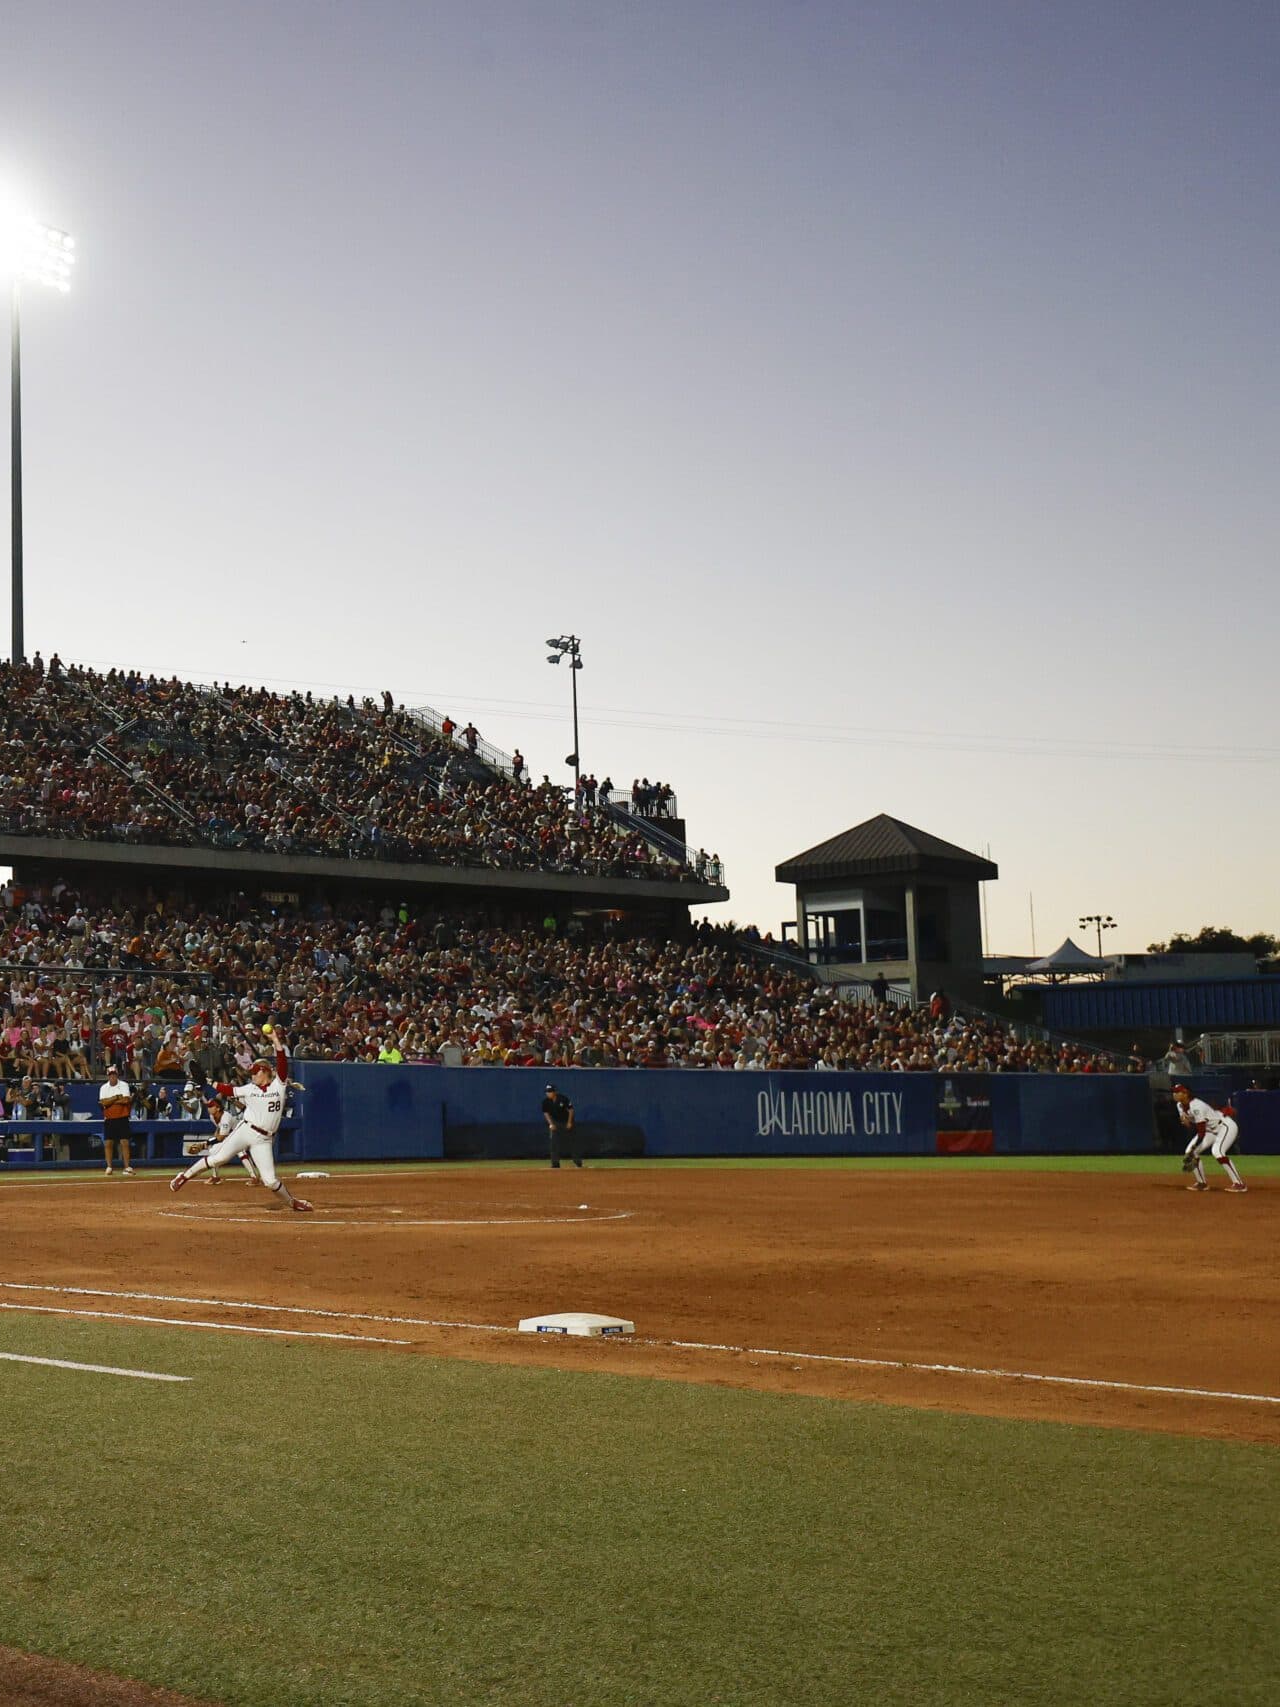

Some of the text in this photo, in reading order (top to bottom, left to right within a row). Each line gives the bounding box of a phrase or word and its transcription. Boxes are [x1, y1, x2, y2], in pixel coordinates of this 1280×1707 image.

[268, 1100, 281, 1113] 28
[756, 1081, 903, 1136] OKLAHOMA CITY
